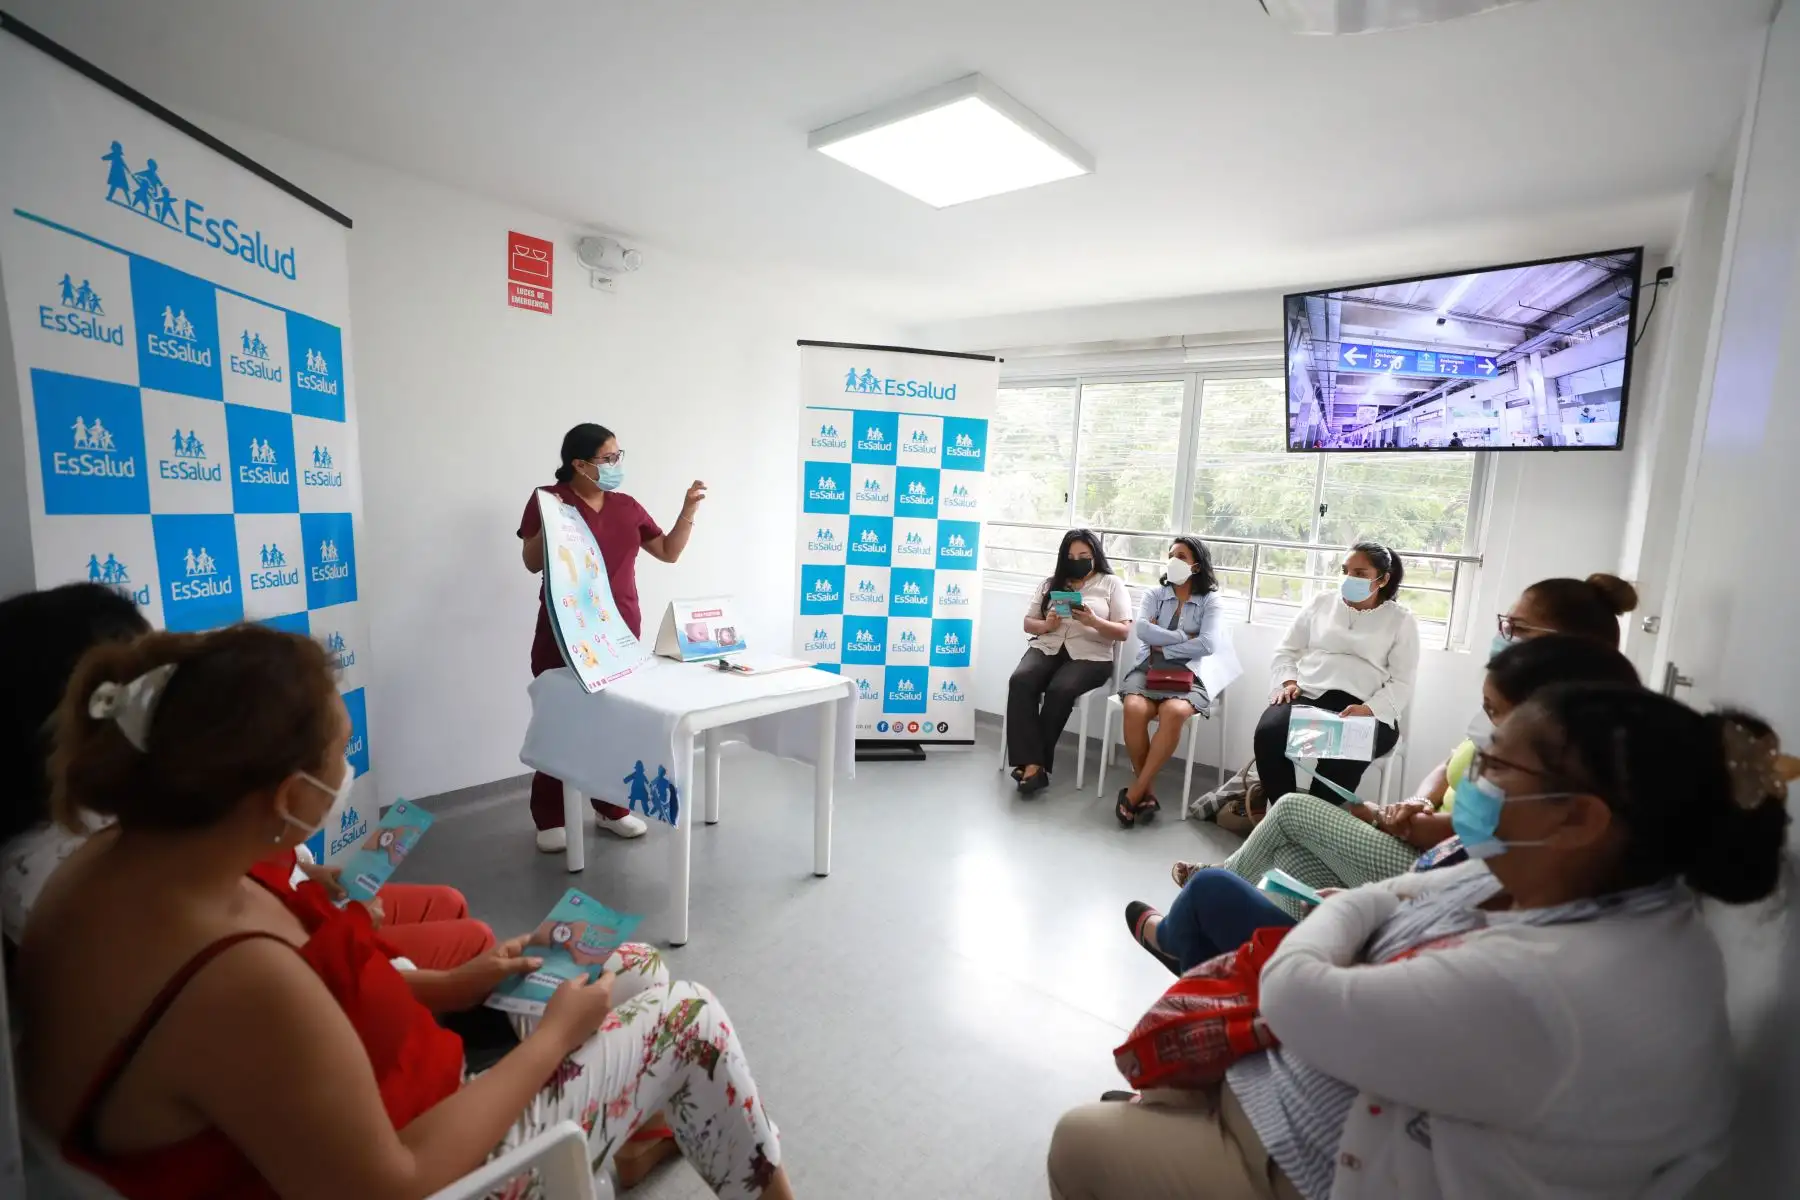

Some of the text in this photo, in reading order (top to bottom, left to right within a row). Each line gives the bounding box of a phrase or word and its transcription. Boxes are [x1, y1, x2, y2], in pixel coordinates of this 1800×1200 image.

[184, 199, 296, 281] EsSalud
[516, 286, 545, 300] LUCES DE
[39, 304, 124, 347] EsSalud
[148, 335, 212, 367] EsSalud
[230, 355, 283, 383] EsSalud
[297, 371, 338, 396] EsSalud
[885, 379, 956, 400] EsSalud
[811, 438, 847, 448] EsSalud
[858, 440, 892, 451] EsSalud
[903, 444, 937, 454] EsSalud
[947, 446, 980, 458] EsSalud
[53, 452, 136, 479] EsSalud
[159, 460, 222, 482] EsSalud
[239, 466, 290, 485] EsSalud
[304, 470, 342, 487] EsSalud
[809, 490, 845, 501] EsSalud
[856, 492, 889, 502] EsSalud
[900, 495, 934, 505] EsSalud
[944, 497, 977, 508] EsSalud
[808, 542, 842, 552] EsSalud
[852, 543, 886, 553] EsSalud
[898, 545, 931, 556] EsSalud
[941, 547, 973, 557] EsSalud
[311, 562, 348, 583] EsSalud
[250, 568, 299, 590] EsSalud
[171, 576, 233, 601] EsSalud
[806, 592, 839, 602] EsSalud
[850, 593, 884, 603] EsSalud
[894, 595, 928, 605] EsSalud
[939, 596, 969, 605] EsSalud
[804, 642, 836, 651] EsSalud
[847, 642, 880, 652] EsSalud
[892, 643, 925, 653] EsSalud
[936, 644, 965, 654] EsSalud
[889, 692, 922, 701] EsSalud
[933, 692, 964, 702] EsSalud
[331, 820, 367, 856] EsSalud
